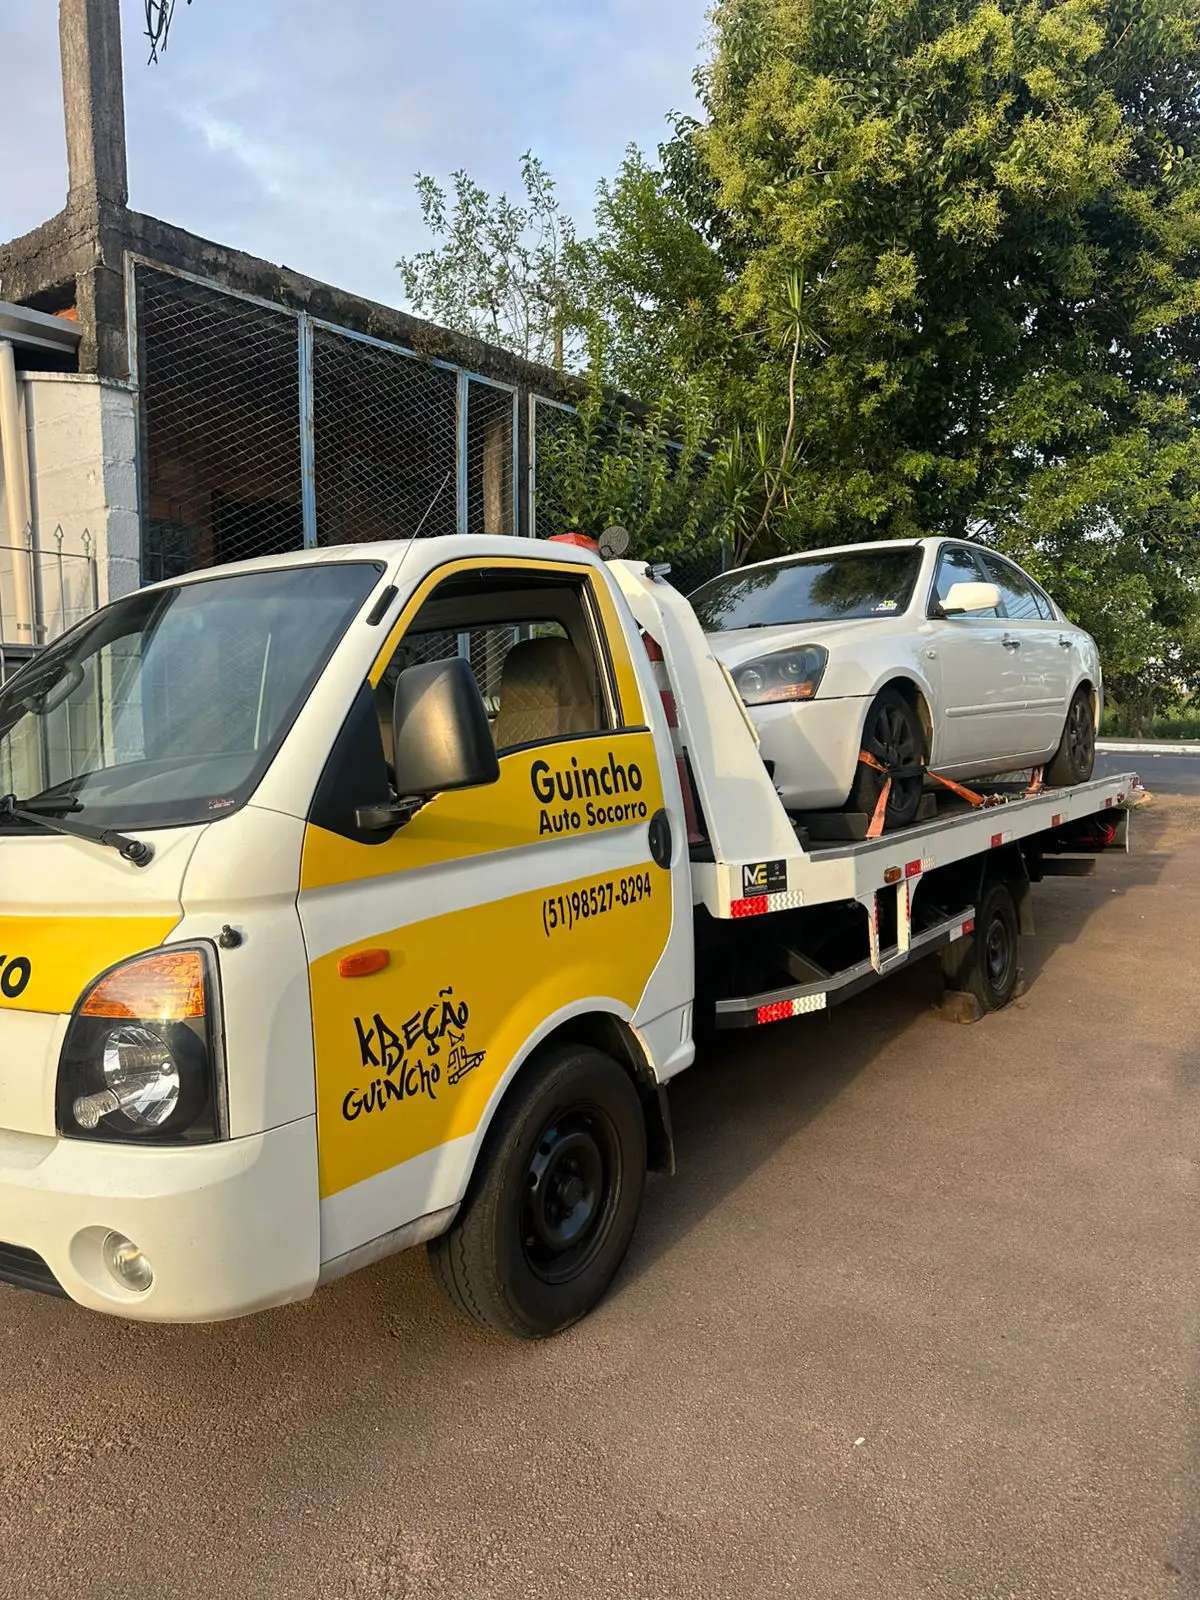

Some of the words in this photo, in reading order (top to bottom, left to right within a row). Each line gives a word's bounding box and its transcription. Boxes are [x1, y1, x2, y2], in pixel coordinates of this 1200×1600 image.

[531, 752, 642, 803] Guincho
[539, 809, 580, 834] Auto
[586, 802, 647, 826] Socorro
[543, 872, 651, 936] (51)98527-8294
